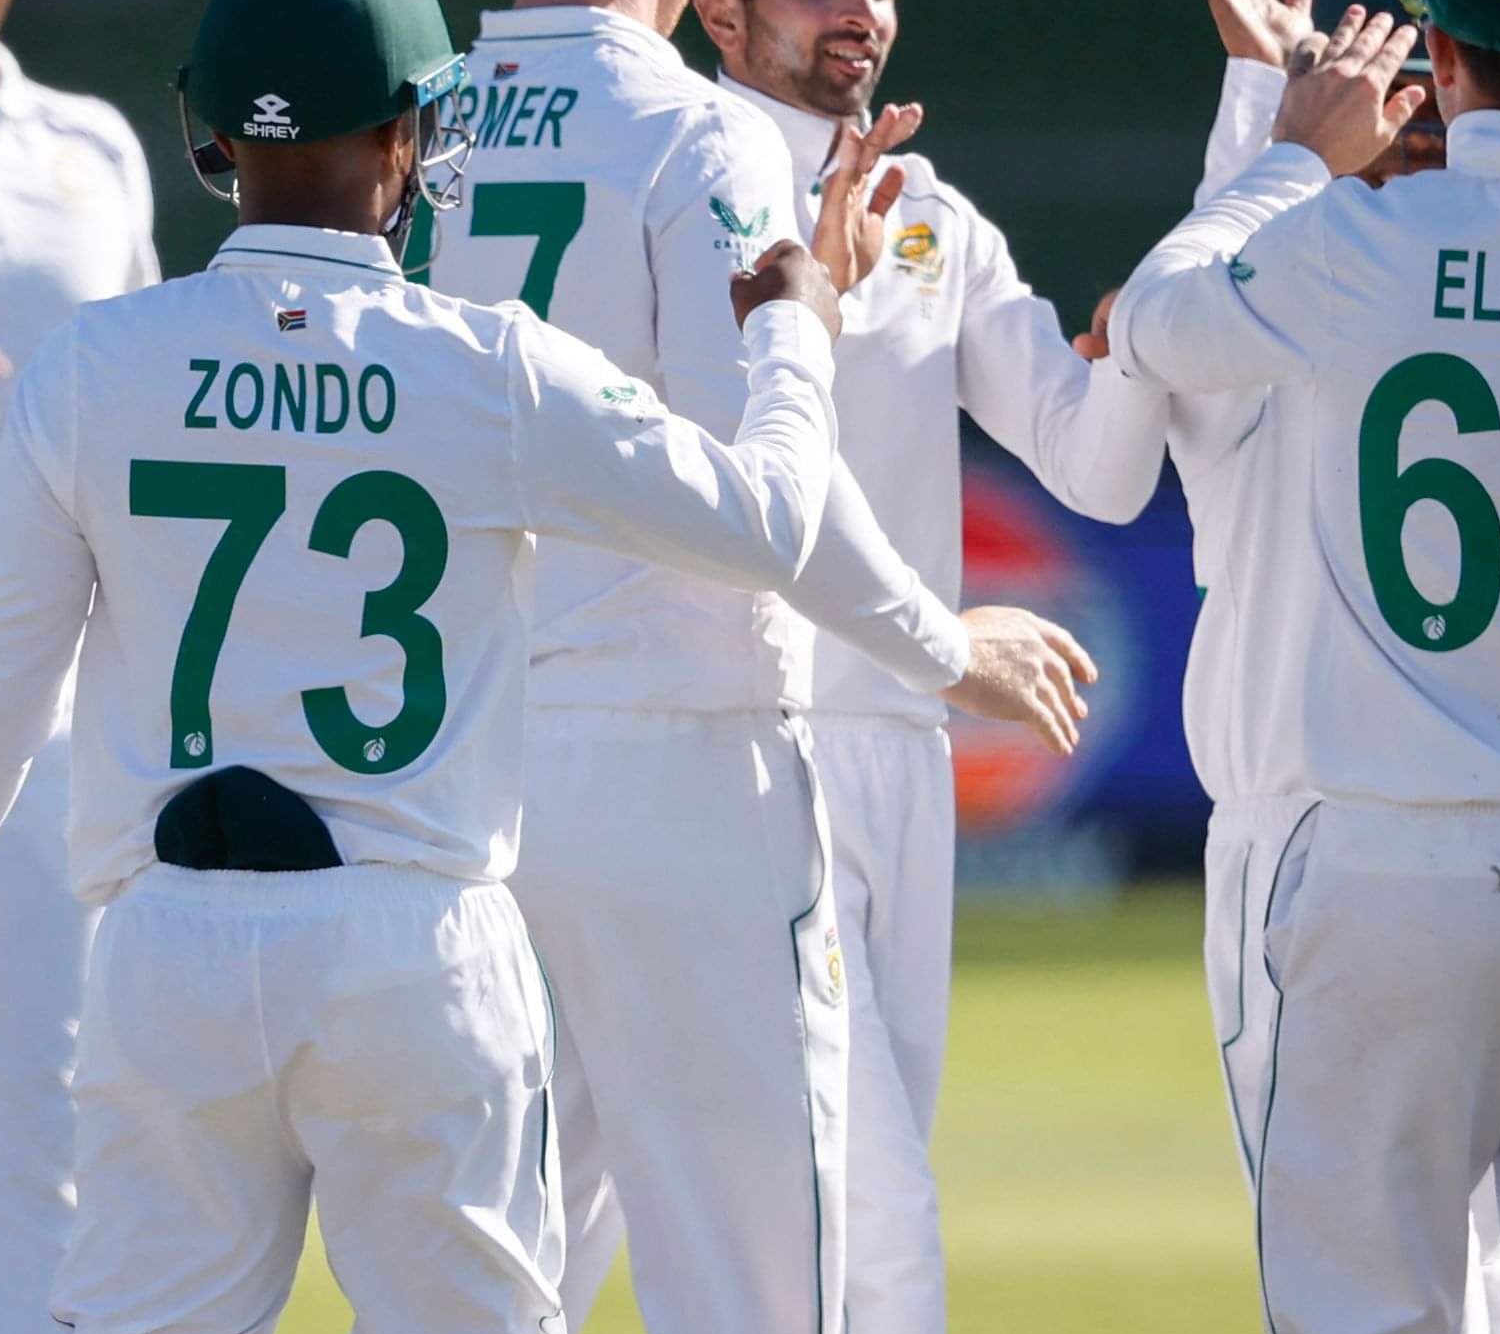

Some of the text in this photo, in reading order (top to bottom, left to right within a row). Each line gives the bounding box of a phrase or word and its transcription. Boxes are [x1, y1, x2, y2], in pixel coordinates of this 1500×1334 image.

[243, 122, 300, 140] SHREY
[437, 85, 579, 148] RMER
[184, 359, 397, 434] ZONDO
[129, 458, 449, 776] 73
